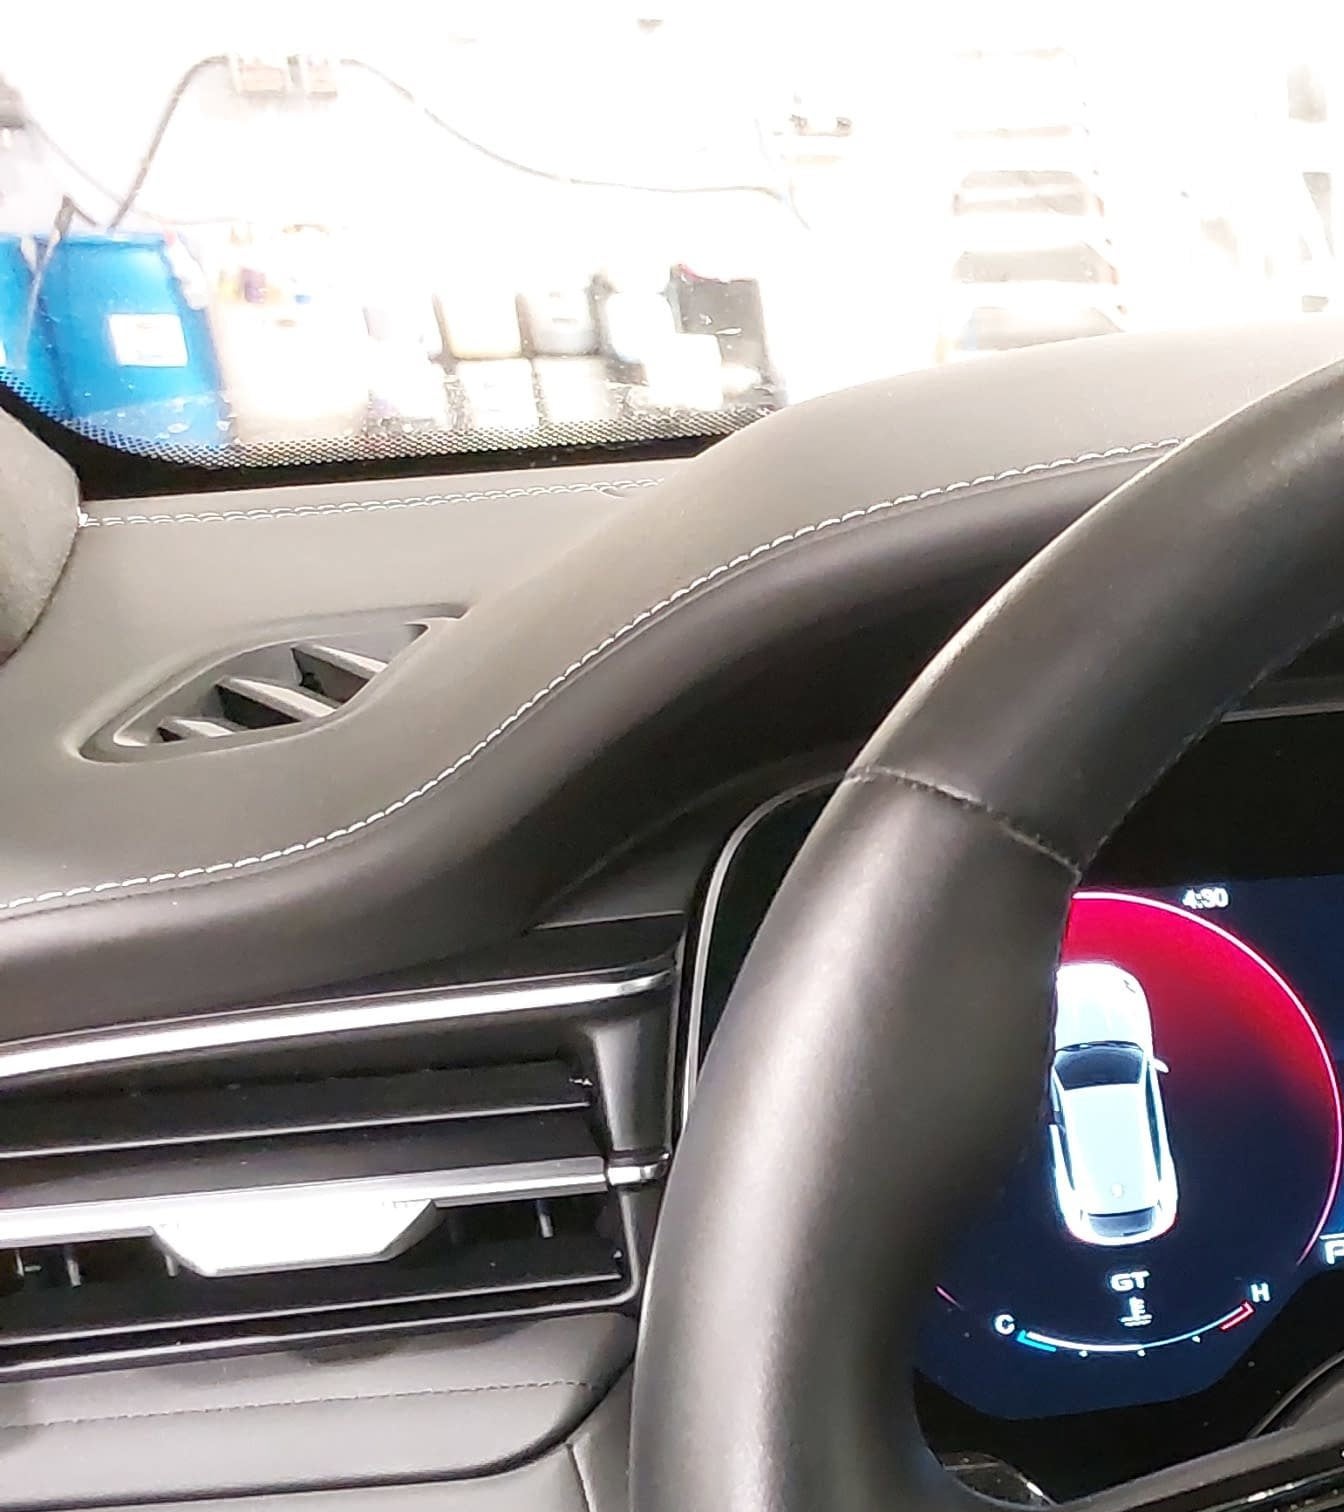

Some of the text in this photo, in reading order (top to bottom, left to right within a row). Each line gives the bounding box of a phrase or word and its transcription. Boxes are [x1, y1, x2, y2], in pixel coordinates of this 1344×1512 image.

[1183, 887, 1229, 909] 4:30
[1110, 1270, 1150, 1292] GT
[1250, 1282, 1271, 1302] H
